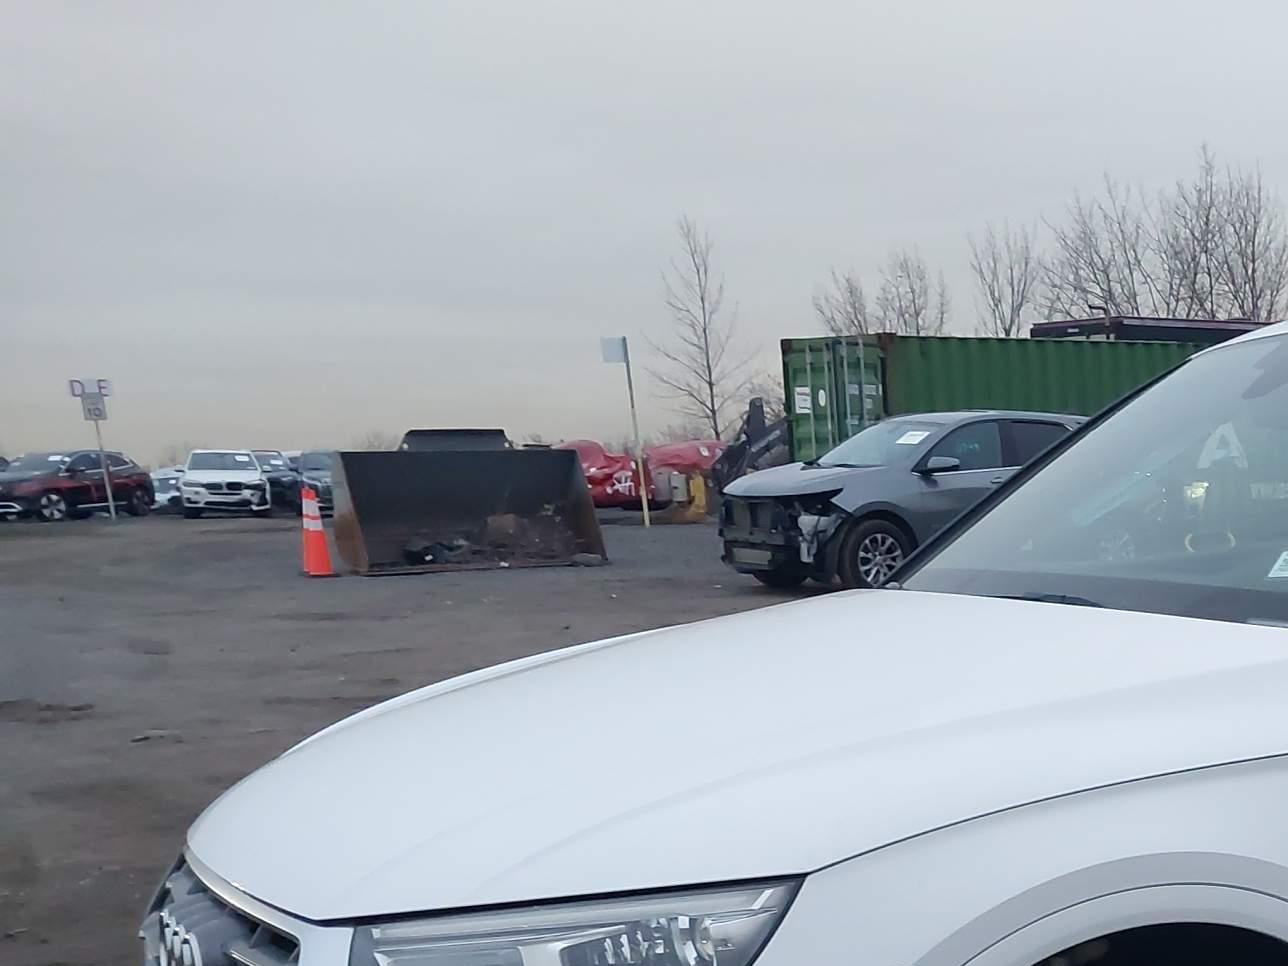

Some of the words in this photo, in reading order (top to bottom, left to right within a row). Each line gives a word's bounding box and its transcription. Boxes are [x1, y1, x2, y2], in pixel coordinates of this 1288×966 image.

[69, 379, 85, 397] D
[97, 379, 110, 397] E
[87, 407, 102, 417] 10
